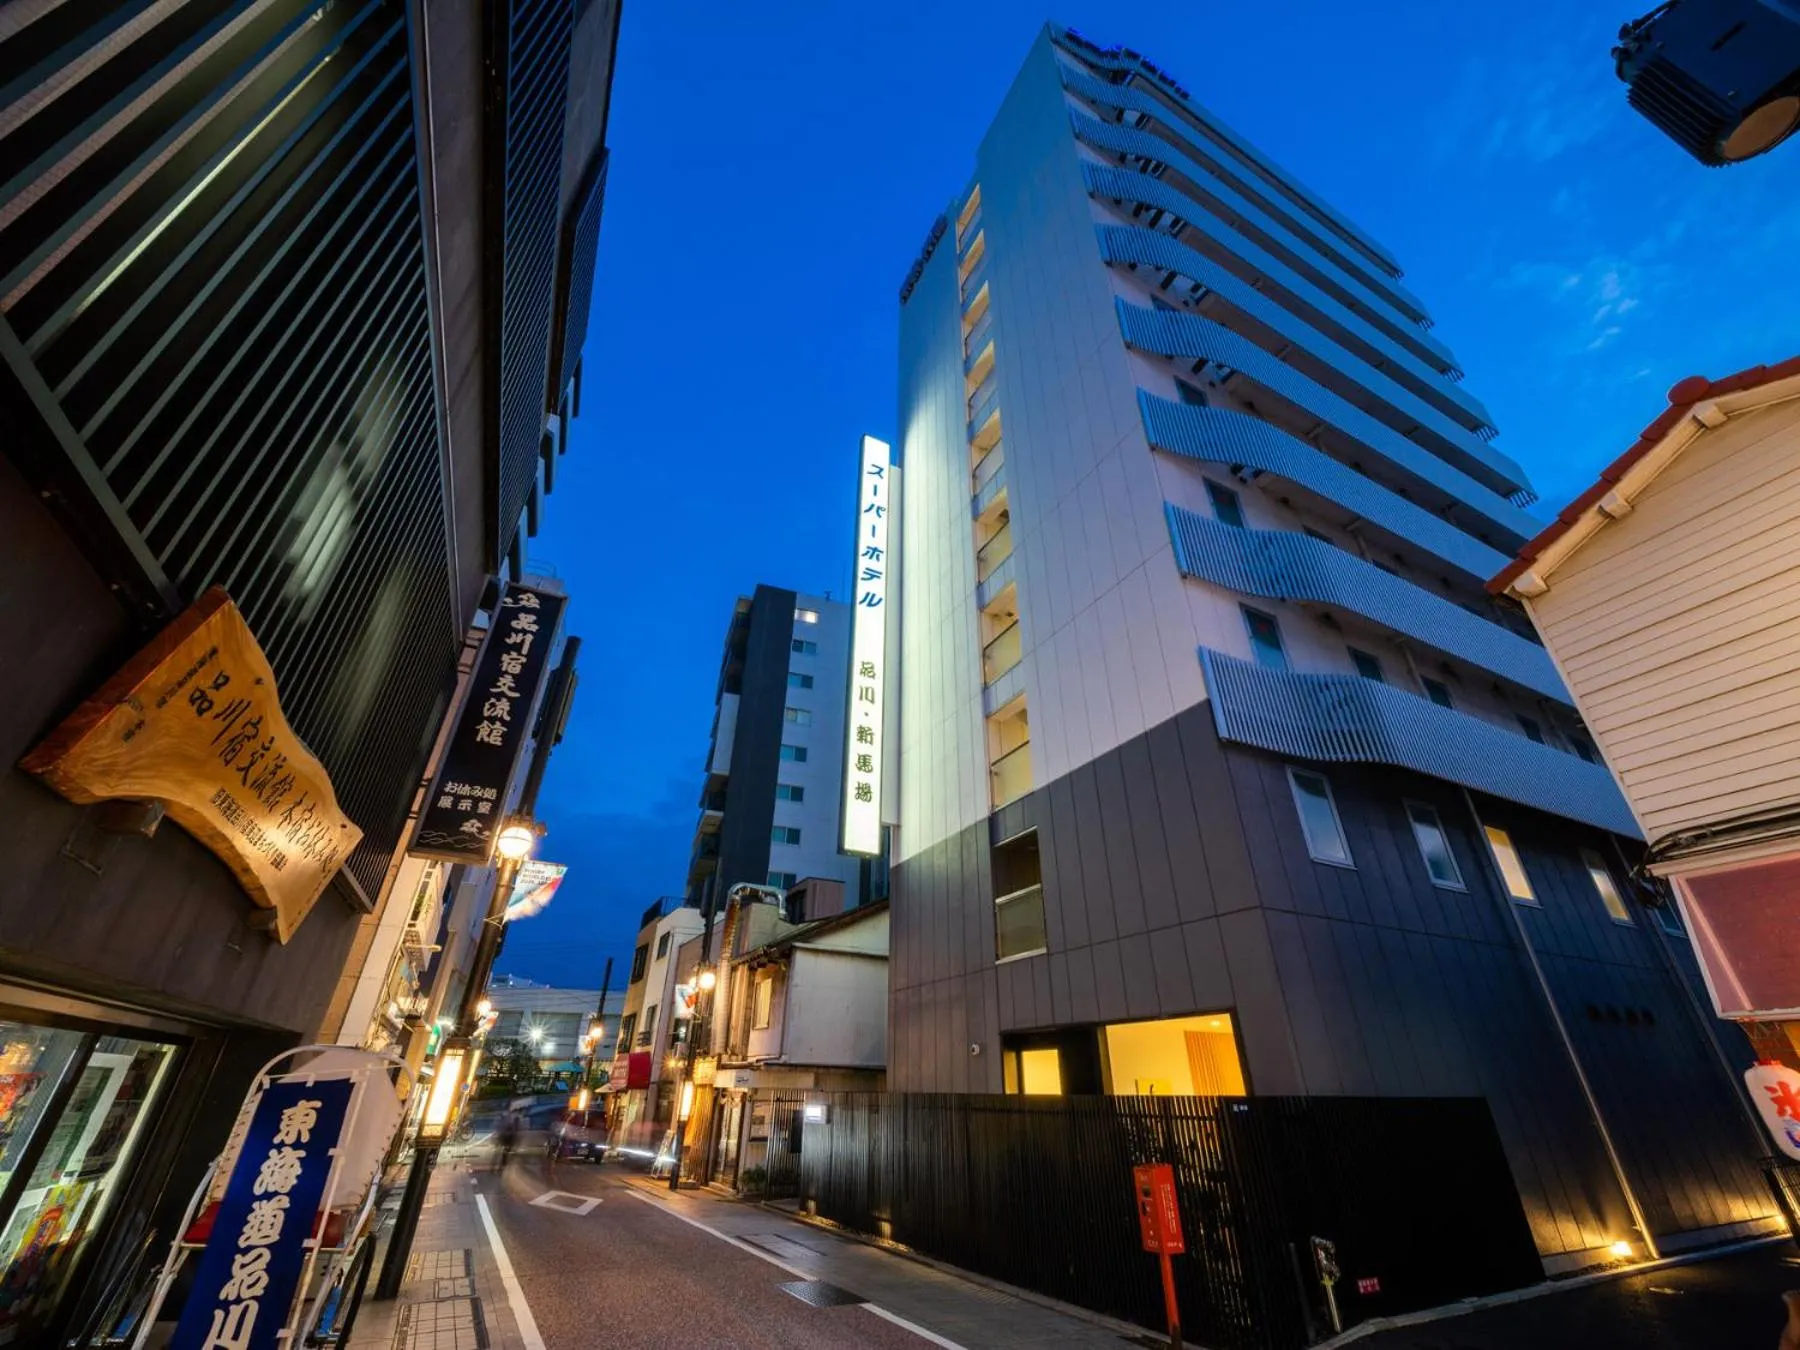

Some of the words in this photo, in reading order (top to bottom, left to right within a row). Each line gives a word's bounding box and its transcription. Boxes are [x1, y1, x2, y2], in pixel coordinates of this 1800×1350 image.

[859, 463, 887, 608] スーパーホテル
[475, 612, 541, 747] 品川宿交流館
[855, 660, 877, 804] 品川・新馬場
[437, 795, 493, 816] 展示室
[443, 780, 498, 801] お休み処
[202, 1100, 323, 1350] 東海道品川
